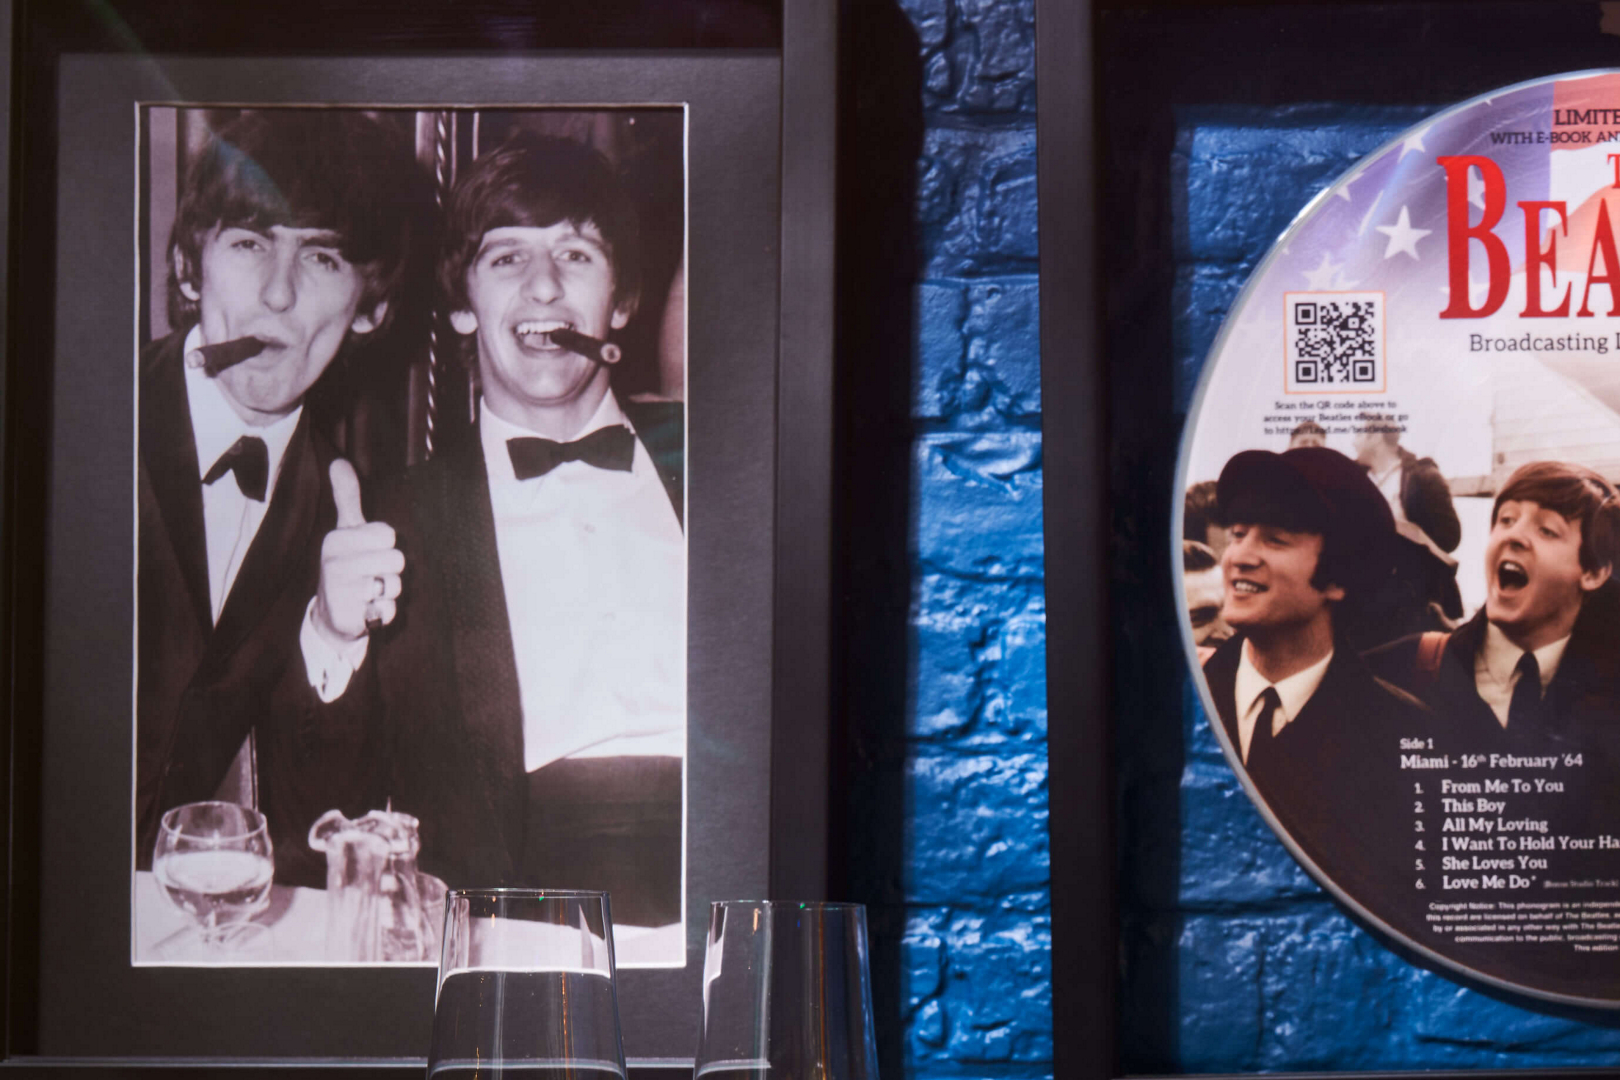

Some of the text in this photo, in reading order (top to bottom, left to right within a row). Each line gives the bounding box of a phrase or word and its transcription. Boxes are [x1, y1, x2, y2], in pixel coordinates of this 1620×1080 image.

[1490, 132, 1534, 144] WITH
[1536, 132, 1592, 144] E-BOOK
[1469, 334, 1608, 354] Broadcasting
[1275, 401, 1297, 410] Scan
[1299, 401, 1314, 410] the
[1316, 401, 1331, 410] QR
[1334, 401, 1355, 409] code
[1357, 401, 1384, 409] above
[1400, 738, 1434, 750] Side 1
[1400, 755, 1449, 769] Miami
[1489, 753, 1558, 770] February
[1441, 779, 1481, 794] From
[1485, 779, 1509, 793] Me
[1511, 778, 1531, 793] To
[1534, 778, 1564, 792] You
[1441, 798, 1474, 813] This
[1476, 798, 1506, 815] Boy
[1442, 818, 1465, 832] All
[1468, 817, 1494, 834] My
[1497, 817, 1548, 834] Loving
[1442, 837, 1448, 851] I
[1451, 837, 1493, 851] Want
[1496, 836, 1516, 851] To
[1519, 836, 1555, 850] Hold
[1558, 836, 1595, 849] Your
[1442, 856, 1469, 871] She
[1472, 856, 1514, 870] Loves
[1517, 856, 1548, 869] You
[1442, 876, 1479, 890] Love
[1482, 875, 1506, 889] Me
